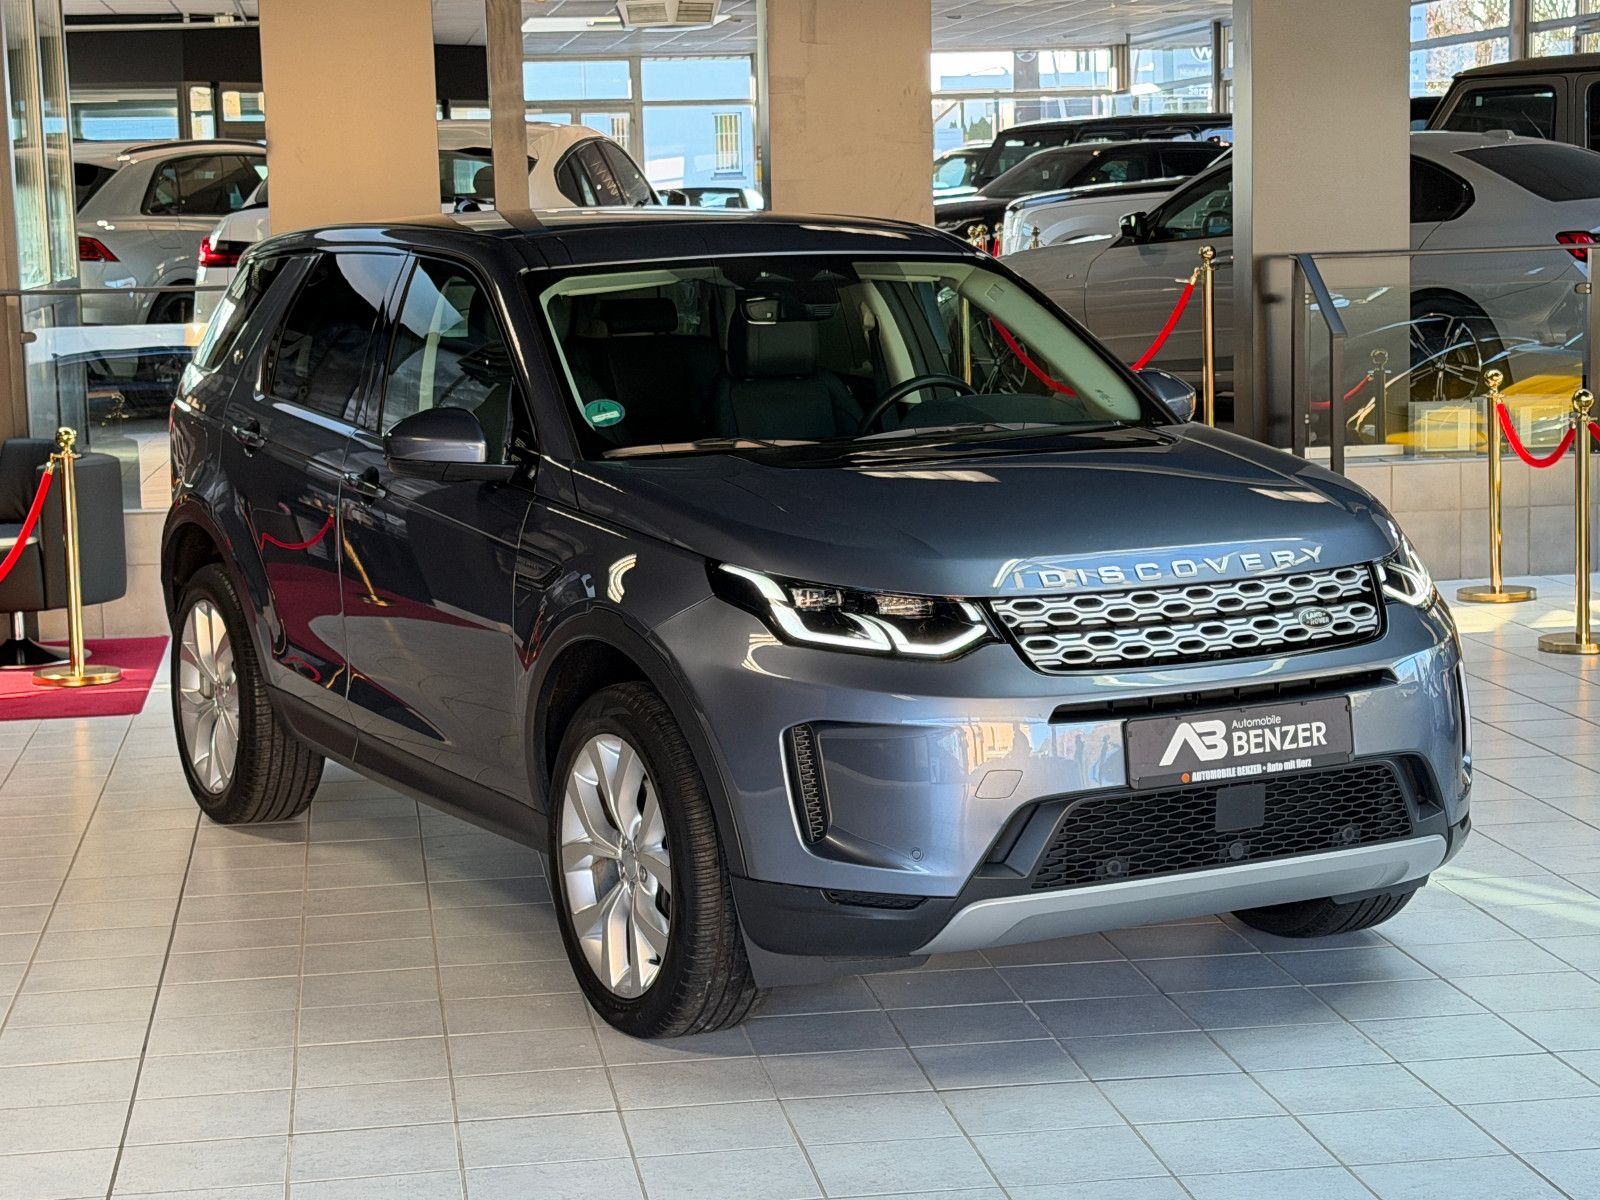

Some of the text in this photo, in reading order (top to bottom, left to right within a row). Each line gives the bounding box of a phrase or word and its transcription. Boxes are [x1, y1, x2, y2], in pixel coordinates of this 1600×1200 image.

[1038, 546, 1322, 588] DISCOVERY
[1232, 715, 1281, 729] Automobile
[1232, 722, 1327, 756] BENZER
[1192, 767, 1236, 782] AUTOMOBILE
